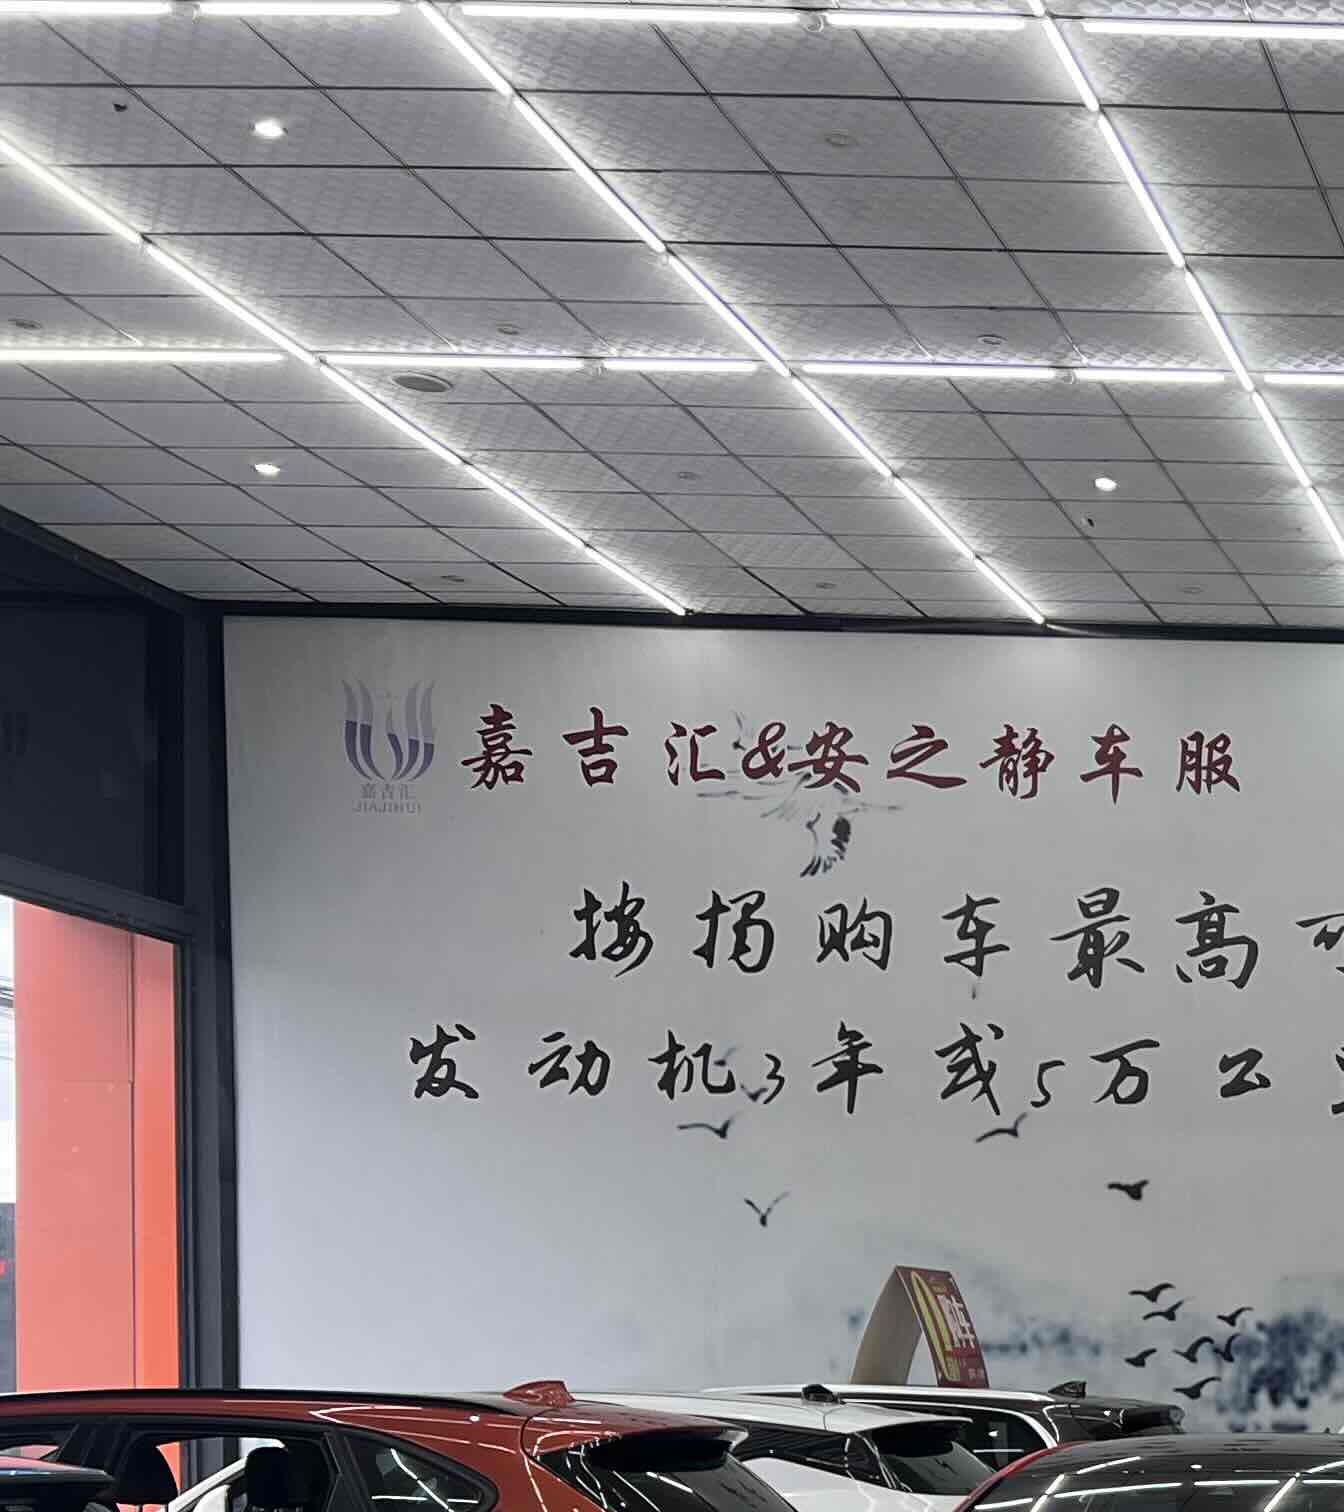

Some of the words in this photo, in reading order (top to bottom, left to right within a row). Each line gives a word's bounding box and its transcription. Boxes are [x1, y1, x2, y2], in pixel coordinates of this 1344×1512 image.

[461, 703, 1241, 804] 嘉吉汇&安之静车服
